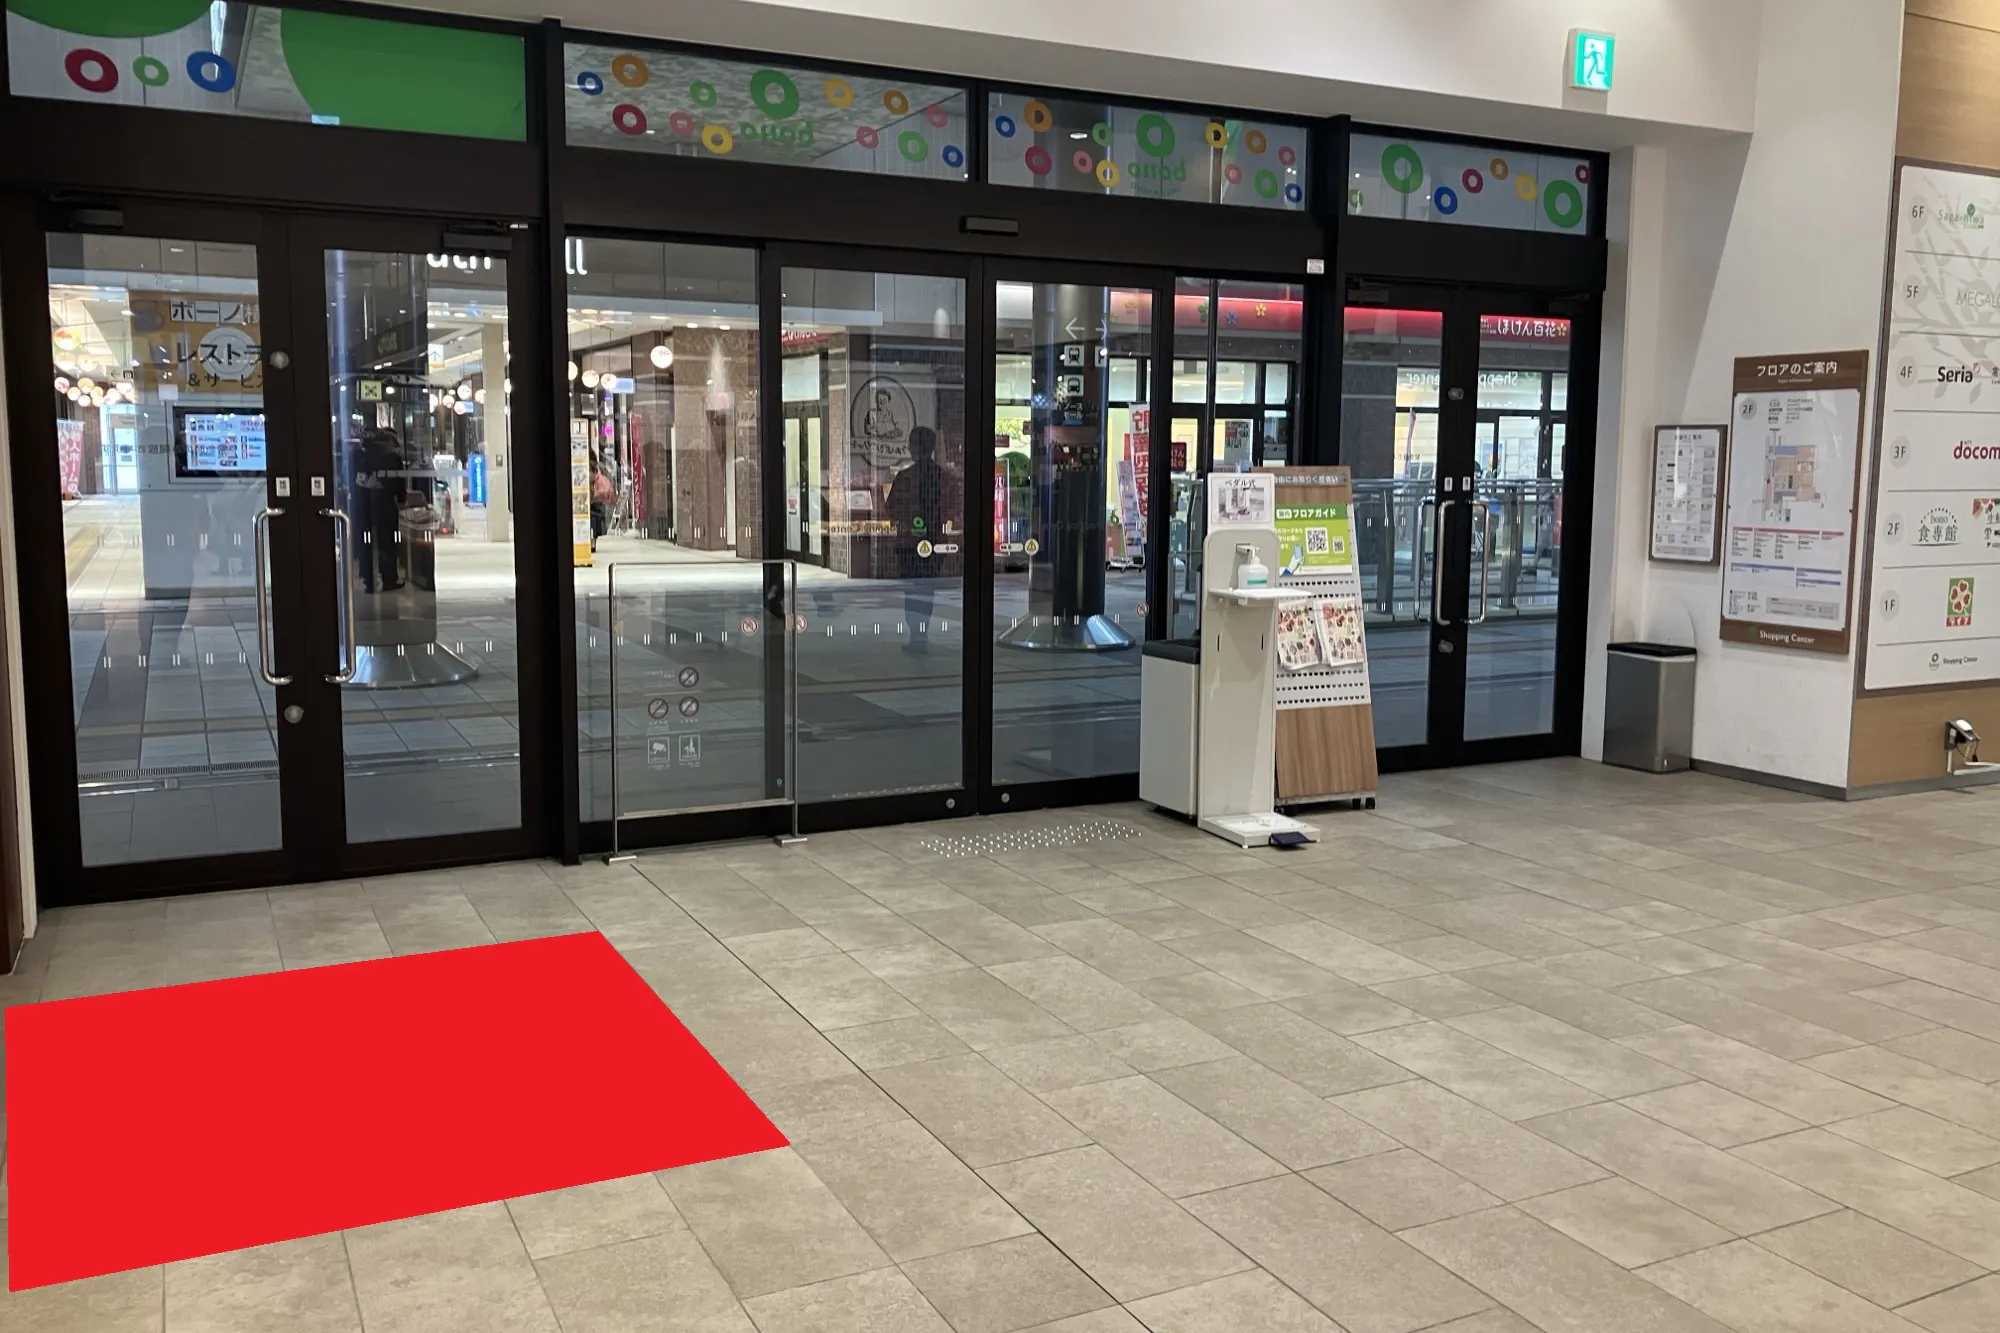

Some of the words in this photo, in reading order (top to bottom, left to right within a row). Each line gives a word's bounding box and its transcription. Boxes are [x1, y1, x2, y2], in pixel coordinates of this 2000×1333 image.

[1912, 206, 1925, 219] 6F
[1906, 285, 1919, 299] 5F
[1497, 319, 1556, 338] ほけん百花
[1757, 361, 1838, 377] フロアのご案内
[1900, 366, 1913, 379] 4F
[1937, 365, 1973, 383] Seria
[1742, 404, 1754, 415] 2F
[1893, 446, 1907, 459] 3F
[1225, 477, 1256, 488] ペダル式
[1292, 508, 1336, 519] フロアガイド
[1887, 522, 1900, 535] 2F
[1918, 524, 1958, 543] 食専館
[1884, 600, 1896, 612] 1F
[1759, 630, 1790, 644] Shopping
[1791, 633, 1815, 645] Center
